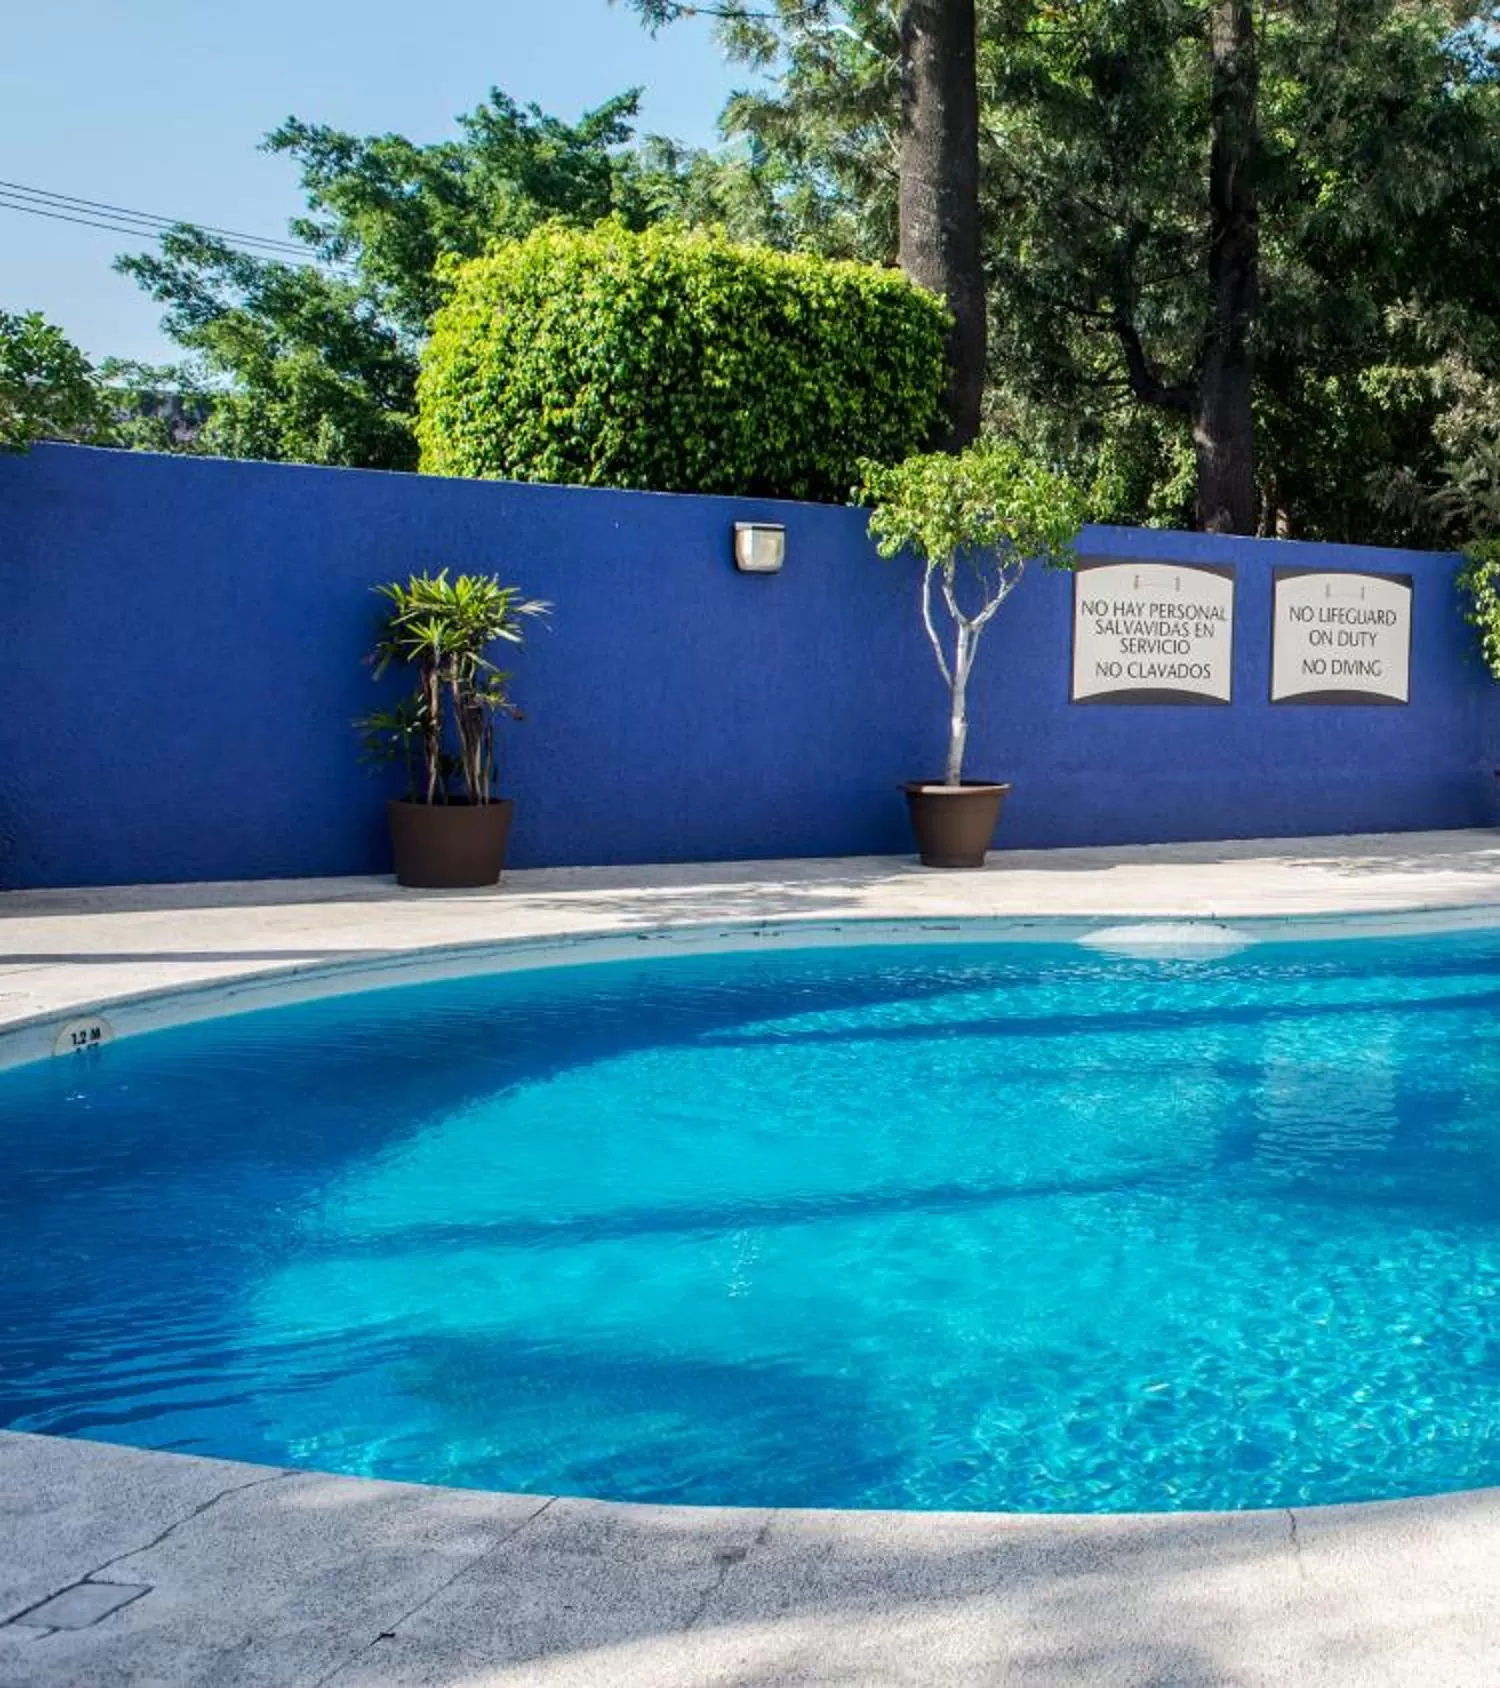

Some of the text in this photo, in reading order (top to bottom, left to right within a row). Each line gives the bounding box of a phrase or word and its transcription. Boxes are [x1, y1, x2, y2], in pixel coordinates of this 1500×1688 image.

[1081, 600, 1228, 622] NO HAY PERSONAL
[1289, 605, 1397, 626] NO LIFEGUARD
[1095, 619, 1215, 638] SALVAVIDAS EN
[1119, 637, 1191, 655] SERVICIO
[1309, 629, 1378, 648] ON DUTY
[1095, 660, 1212, 680] NO CLAVADOS
[1302, 658, 1383, 677] NO DIVING
